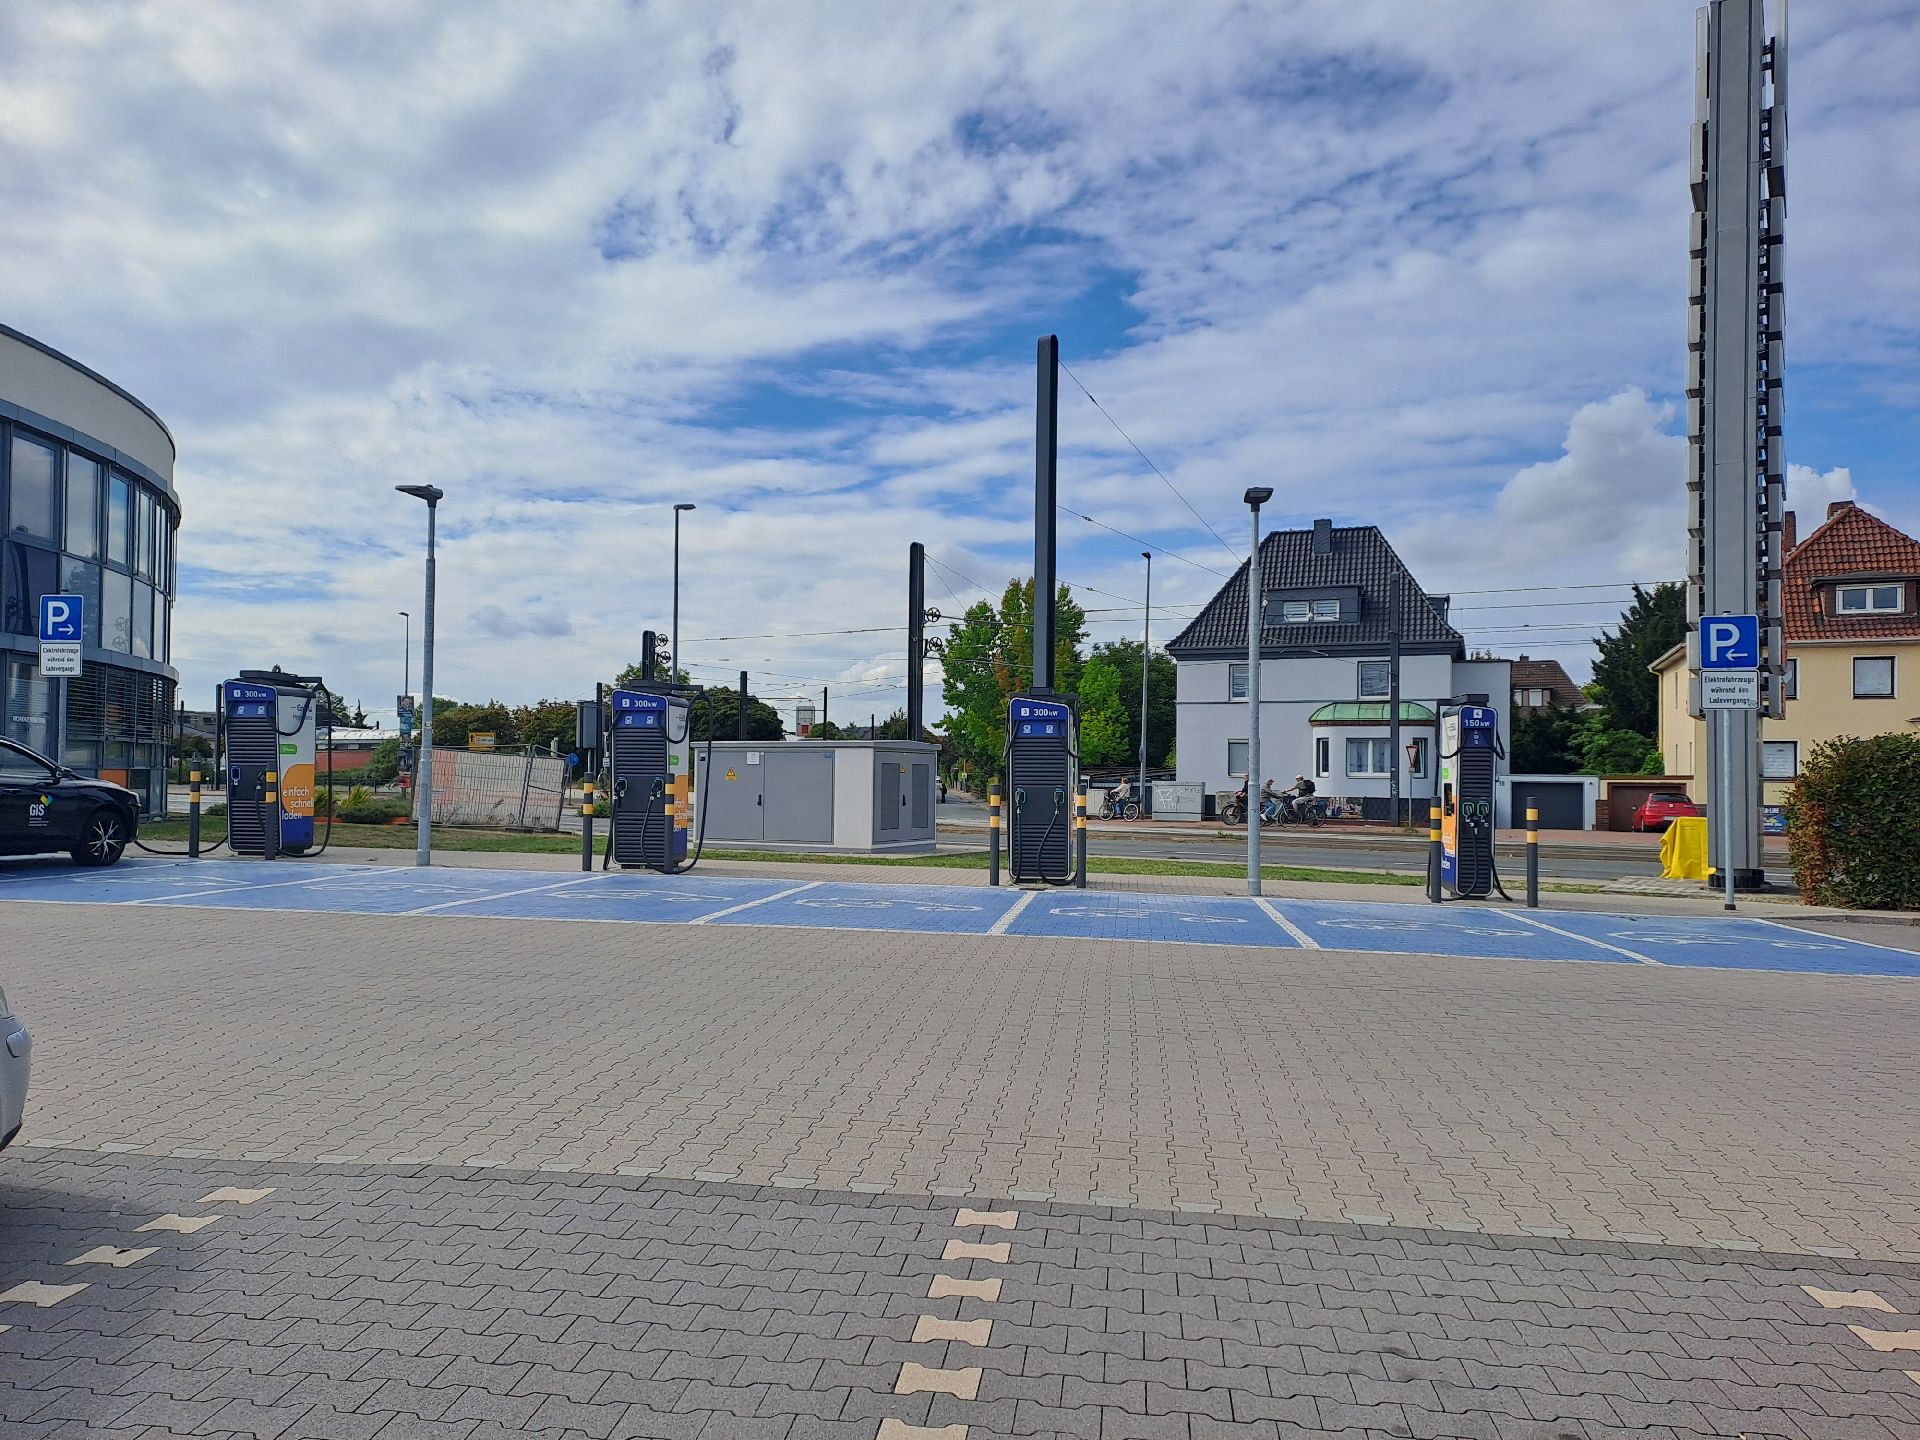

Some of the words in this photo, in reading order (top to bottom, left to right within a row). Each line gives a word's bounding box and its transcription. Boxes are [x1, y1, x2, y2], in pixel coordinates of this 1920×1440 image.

[47, 601, 70, 635] P
[1709, 623, 1740, 662] P
[1704, 676, 1755, 684] Elektrofahrzeuge
[1709, 697, 1750, 705] Ladevorgangs
[282, 786, 310, 797] einfach
[282, 810, 302, 820] laden
